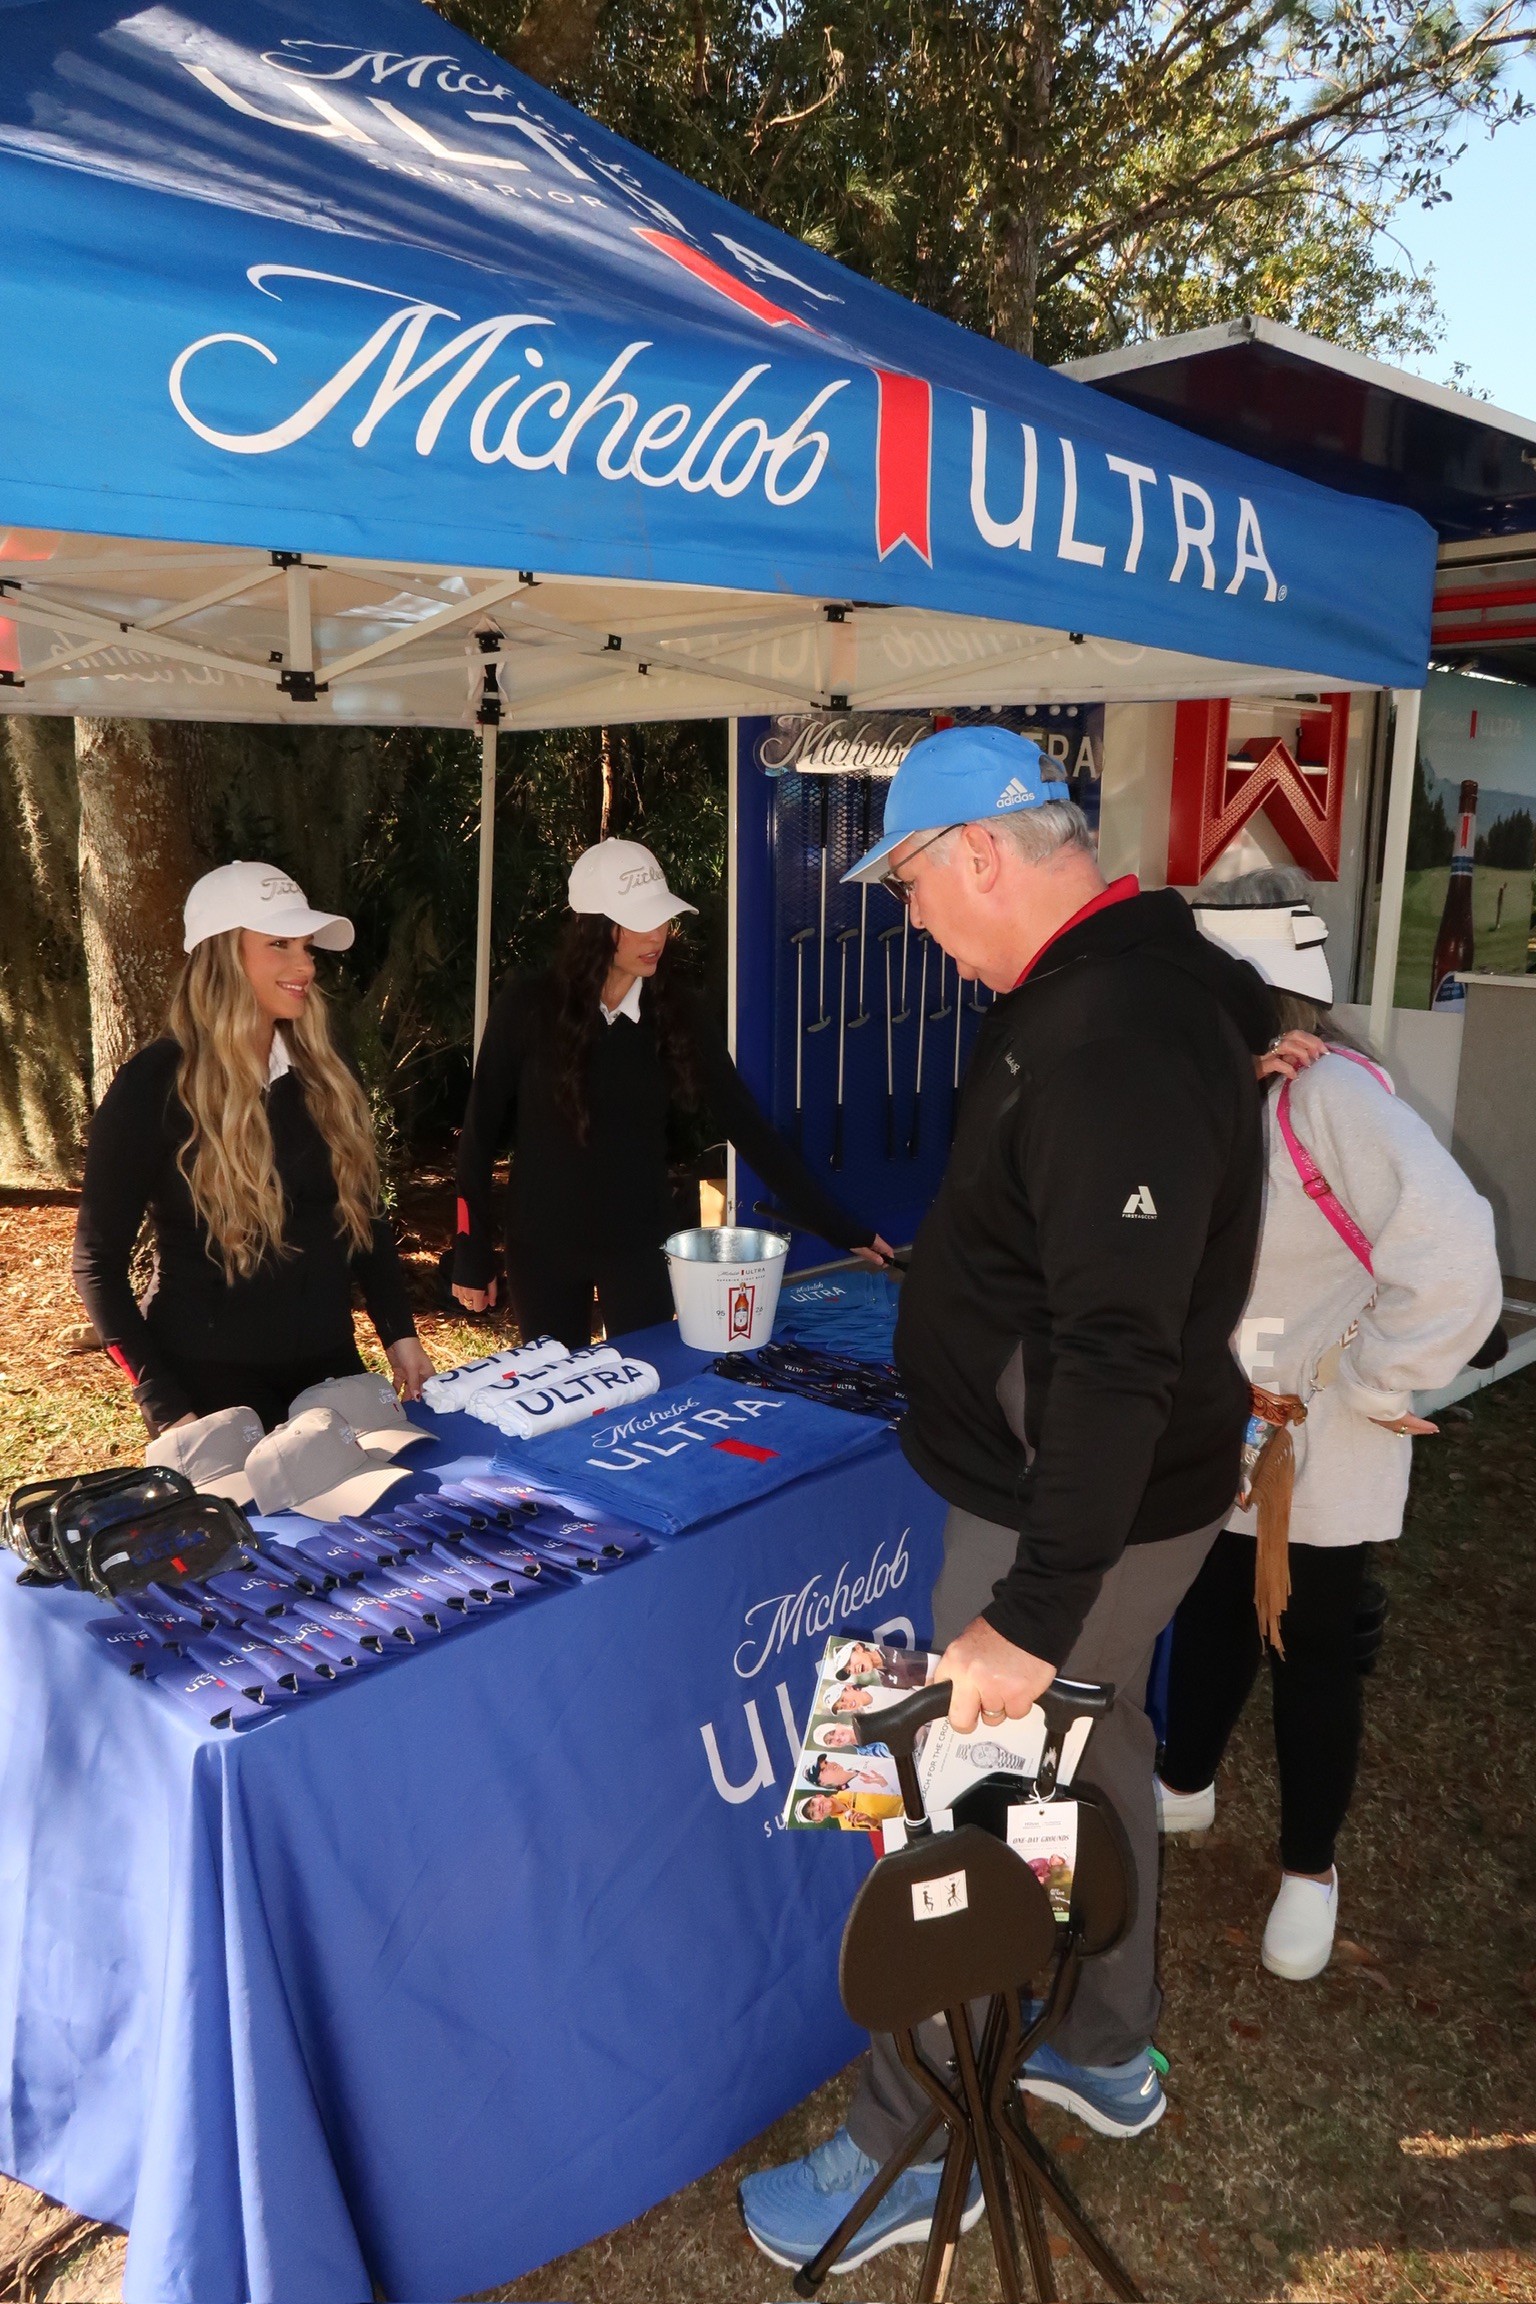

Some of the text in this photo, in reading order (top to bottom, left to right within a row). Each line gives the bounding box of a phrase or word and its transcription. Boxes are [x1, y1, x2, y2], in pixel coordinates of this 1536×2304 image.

[168, 264, 852, 506] Michelob
[996, 792, 1036, 809] adidas
[745, 1267, 766, 1275] ULTRA
[790, 1286, 847, 1303] ULTRA
[784, 1363, 804, 1374] ULTRA
[516, 1364, 644, 1416] ULTRA
[836, 1383, 856, 1391] ULTRA
[591, 1396, 700, 1449] Michelob
[585, 1399, 784, 1471] ULTRA
[733, 1527, 911, 1679] Michelob
[137, 1613, 187, 1624] ULTRA
[107, 1633, 150, 1644] ULTR
[184, 1675, 217, 1693] ULT
[927, 1761, 938, 1778] FOR
[933, 1743, 943, 1760] THE
[1040, 1834, 1070, 1843] GROUNDS
